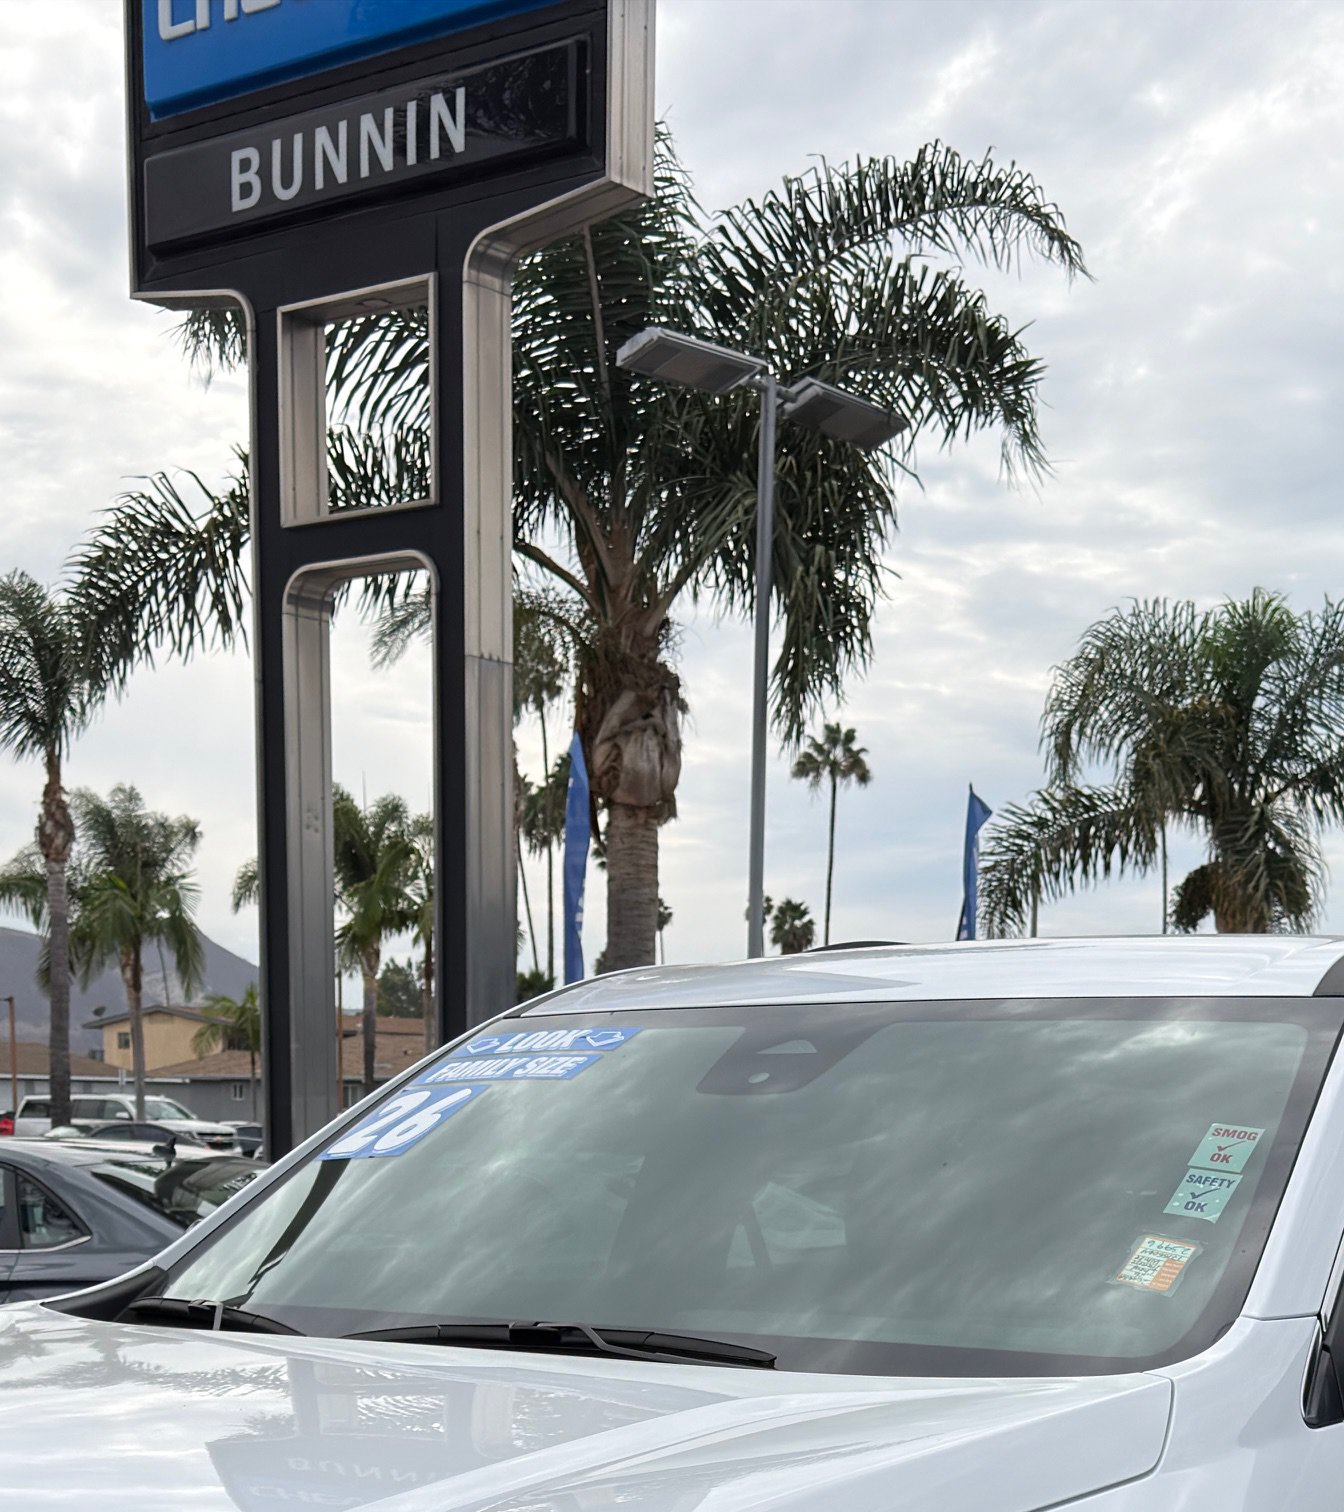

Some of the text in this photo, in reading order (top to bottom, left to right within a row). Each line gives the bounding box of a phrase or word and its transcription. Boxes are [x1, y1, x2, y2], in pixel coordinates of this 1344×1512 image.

[231, 86, 466, 212] BUNNIN
[497, 1029, 590, 1053] LOOK
[424, 1056, 588, 1083] FAMILY SIZE
[326, 1088, 472, 1156] 26
[1211, 1128, 1258, 1141] SMOG
[1210, 1153, 1233, 1164] OK
[1186, 1174, 1236, 1189] SAFETY
[1184, 1201, 1208, 1213] OK
